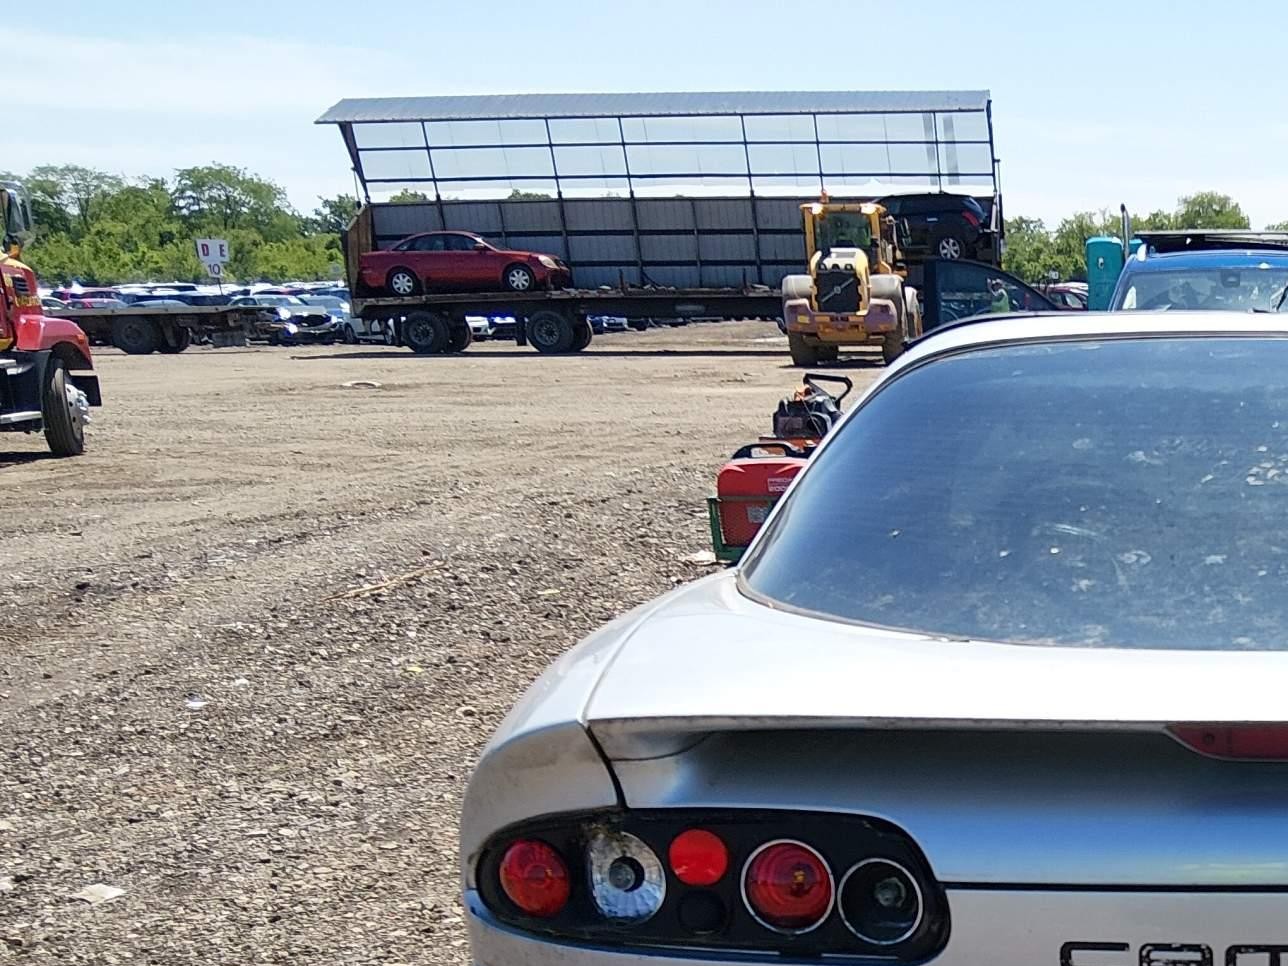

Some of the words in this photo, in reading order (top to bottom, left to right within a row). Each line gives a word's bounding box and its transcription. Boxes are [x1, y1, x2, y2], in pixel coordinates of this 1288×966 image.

[201, 243, 210, 257] D
[218, 244, 226, 258] E
[207, 263, 221, 276] 10
